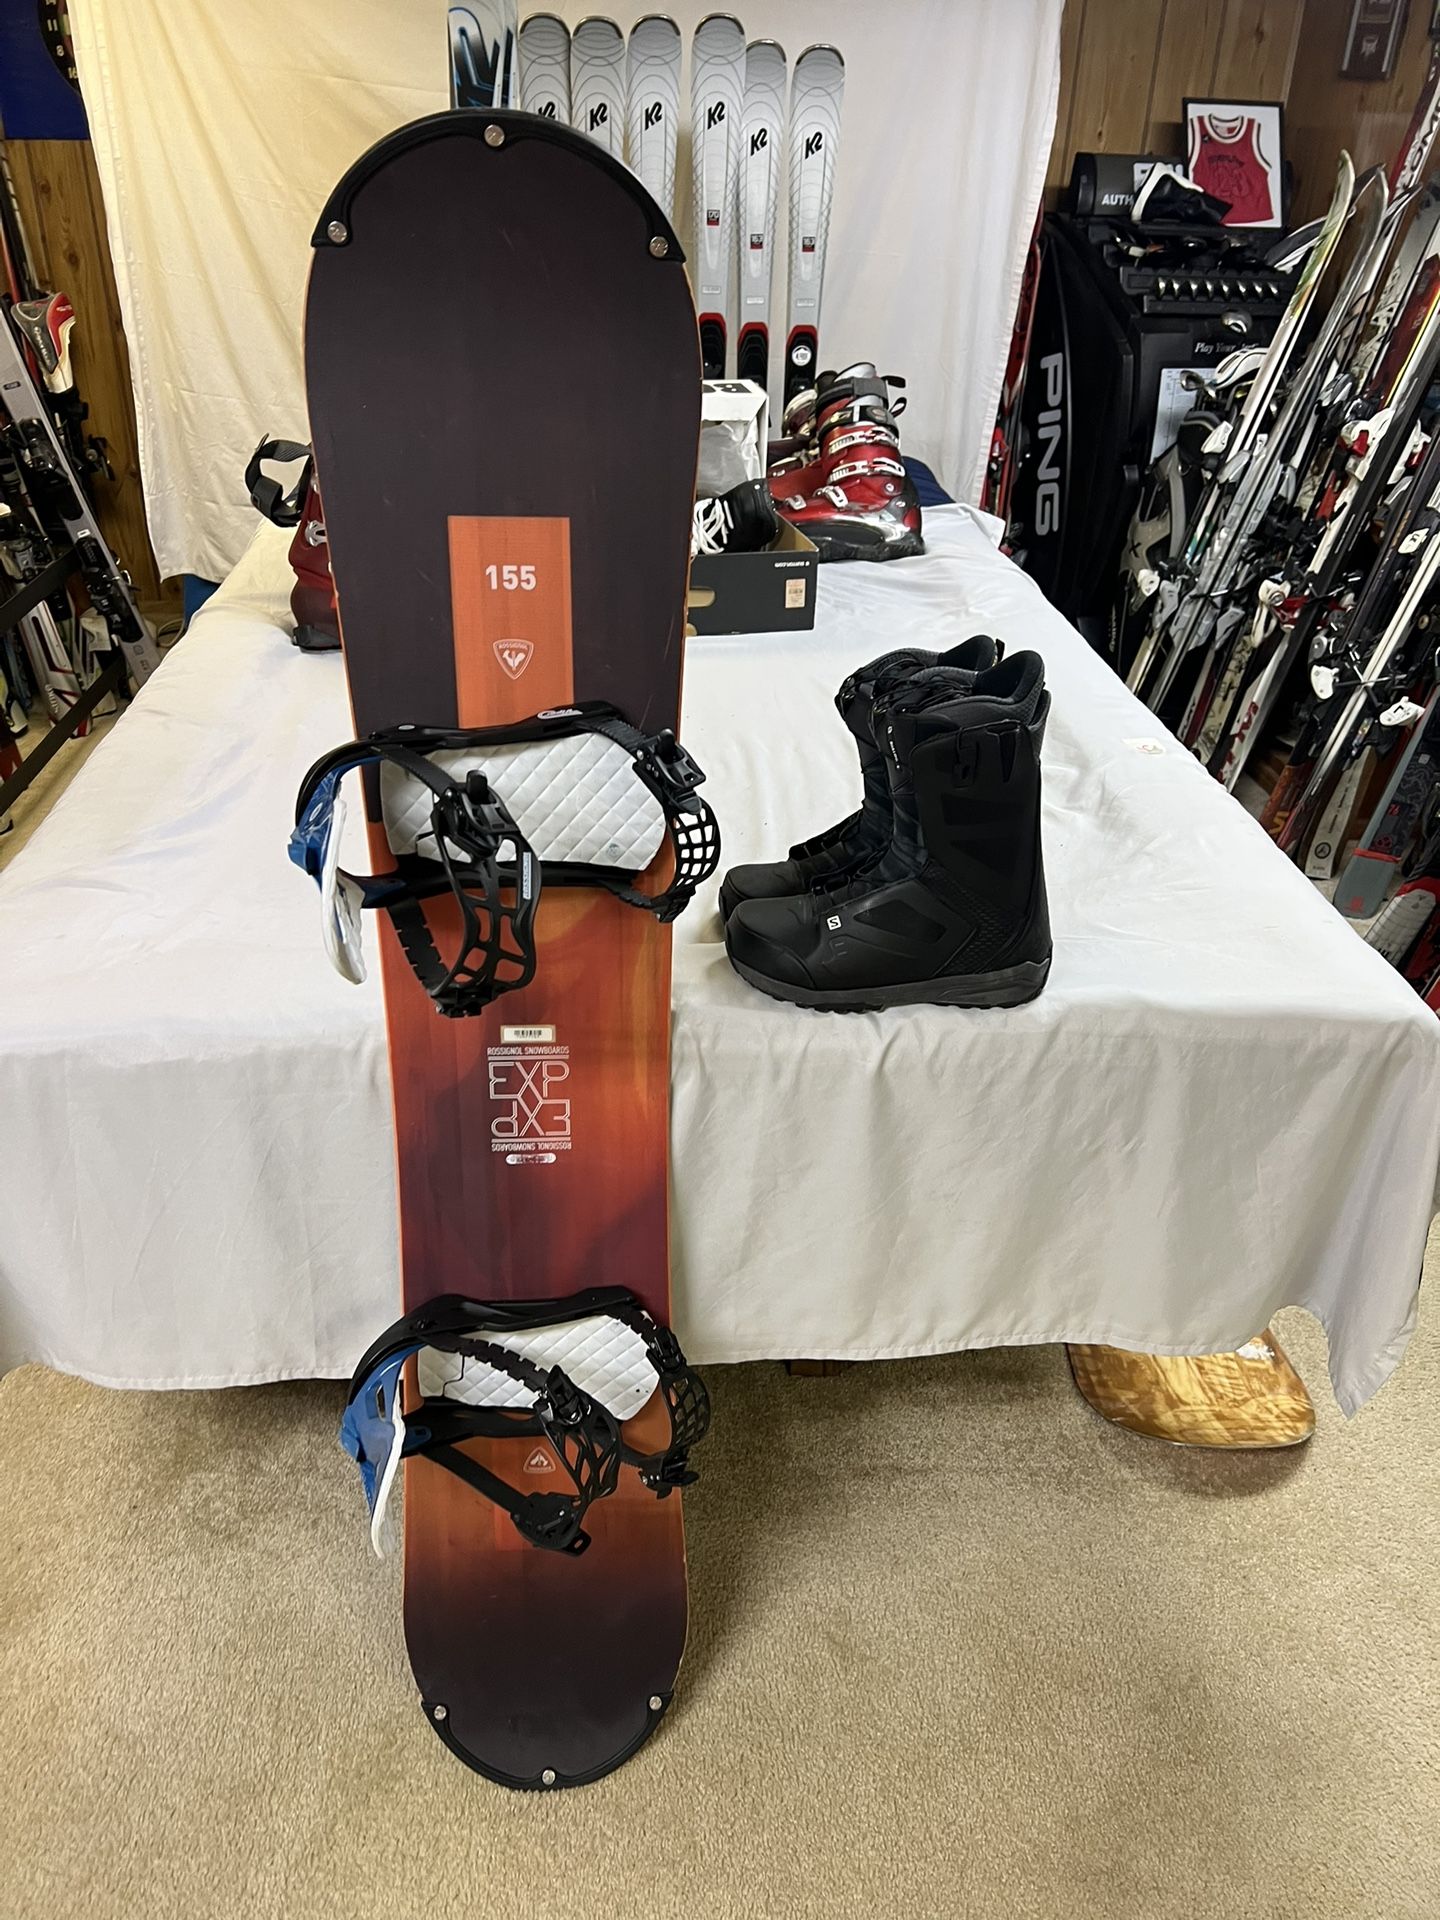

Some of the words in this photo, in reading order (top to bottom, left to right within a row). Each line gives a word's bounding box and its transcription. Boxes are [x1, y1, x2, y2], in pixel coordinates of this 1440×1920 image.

[47, 19, 58, 31] 11
[56, 45, 65, 57] 8
[590, 102, 607, 131] K2
[645, 101, 662, 131] K2
[707, 100, 725, 130] K2
[750, 127, 767, 156] K2
[805, 131, 823, 159] K2
[1101, 193, 1134, 206] AUTH
[1035, 352, 1064, 537] PING
[485, 564, 537, 591] 155
[487, 1047, 523, 1056] ROSSIGNOL
[524, 1046, 570, 1055] SNOWBOARDS
[489, 1061, 569, 1099] EXP
